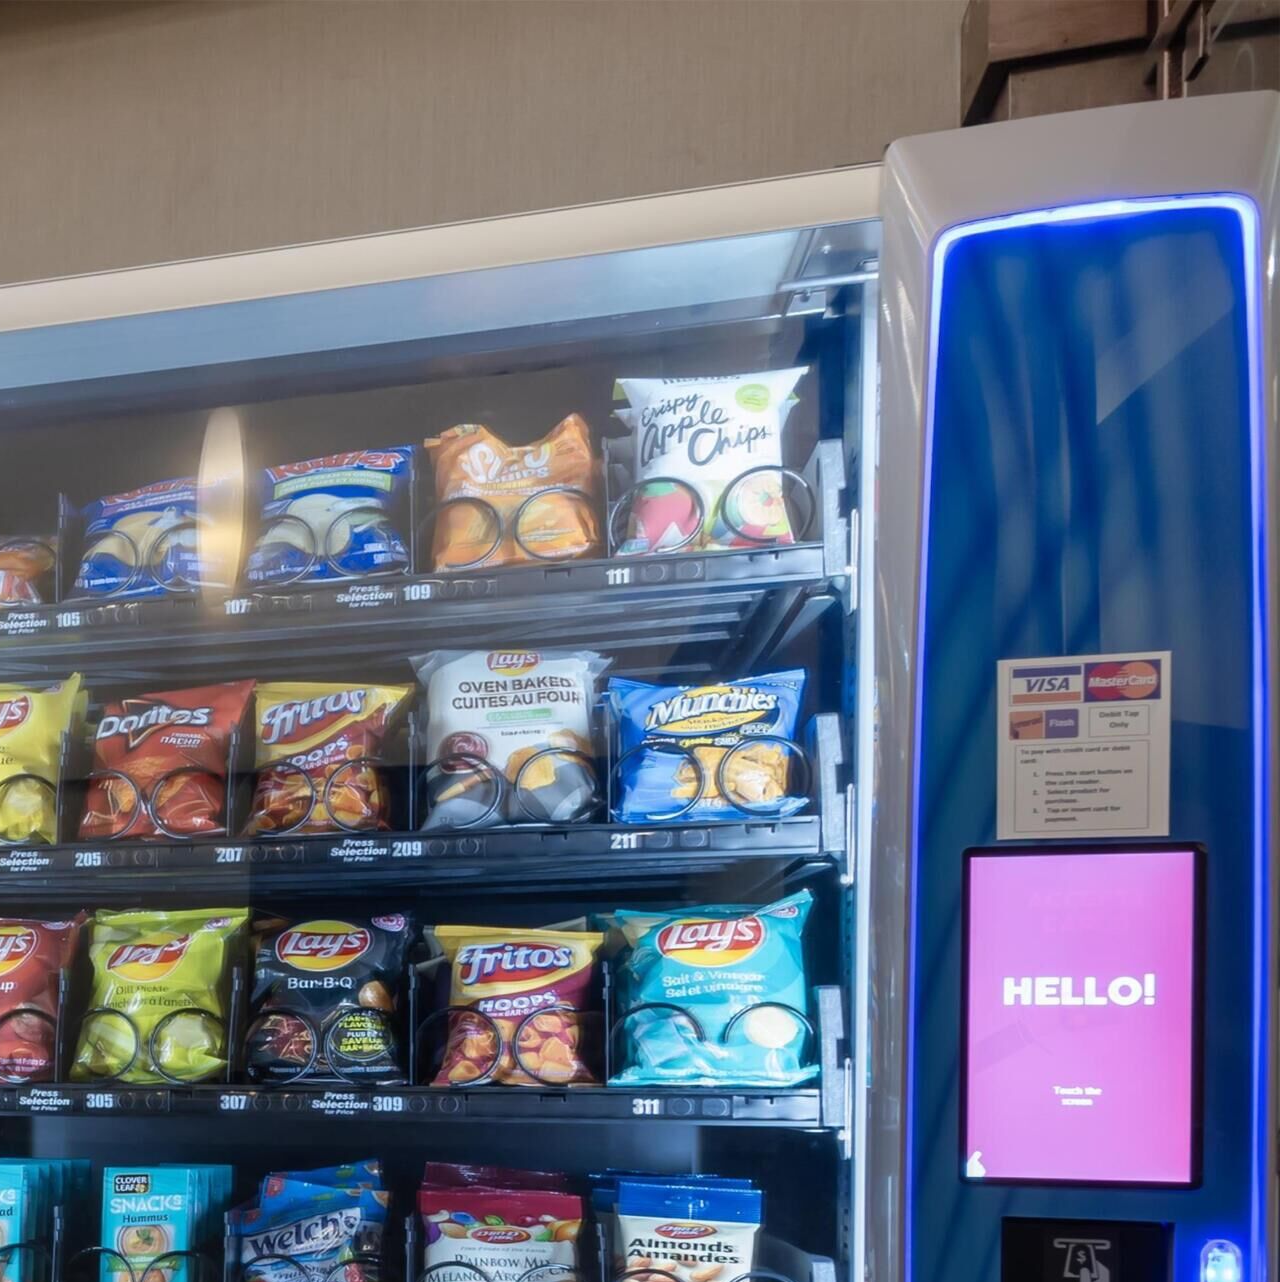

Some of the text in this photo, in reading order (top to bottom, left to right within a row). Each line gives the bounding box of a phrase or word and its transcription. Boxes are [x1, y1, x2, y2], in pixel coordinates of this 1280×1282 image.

[641, 392, 702, 426] Crispy
[641, 400, 731, 467] Apple
[688, 425, 771, 466] Chips
[606, 568, 631, 585] 111
[403, 584, 431, 600] 109
[225, 600, 247, 614] 107
[8, 613, 35, 622] Press
[56, 612, 81, 627] 105
[490, 650, 538, 670] Lay's
[458, 676, 574, 695] OVEN BAKED
[1025, 675, 1159, 693] VISA MasterCard
[452, 696, 507, 710] CUITES
[510, 693, 533, 707] AU
[261, 688, 367, 745] Fritos
[644, 687, 778, 732] Munchies
[1124, 710, 1140, 719] Tap
[96, 706, 211, 740] Doritos
[1049, 718, 1076, 727] Flash
[1109, 721, 1130, 730] Only
[160, 736, 202, 748] NACHO
[611, 833, 637, 848] 211
[11, 850, 38, 858] Press
[217, 848, 242, 862] 207
[392, 841, 422, 856] 209
[0, 856, 50, 867] Selection
[75, 853, 102, 866] 205
[664, 917, 758, 952] Lay's
[284, 928, 365, 962] Lay's
[456, 943, 573, 985] Fritos
[662, 971, 765, 987] Salt & Vinegar
[665, 983, 764, 998] Sel et vinaigre
[1003, 974, 1156, 1007] HELLO!
[478, 992, 557, 1012] HOOPS
[31, 1089, 58, 1098] Press
[1053, 1085, 1102, 1096] Touch the
[19, 1095, 70, 1107] Selection
[86, 1094, 113, 1108] 305
[221, 1095, 246, 1109] 307
[373, 1097, 403, 1111] 309
[633, 1099, 659, 1114] 311
[1061, 1097, 1093, 1107] screen
[115, 1176, 148, 1185] CLOVER
[115, 1184, 136, 1193] LEAF
[110, 1195, 186, 1214] SNACKS
[122, 1212, 169, 1224] Hummus
[250, 1210, 358, 1257] Welch's
[629, 1237, 734, 1254] Almonds
[627, 1249, 740, 1265] Amandes
